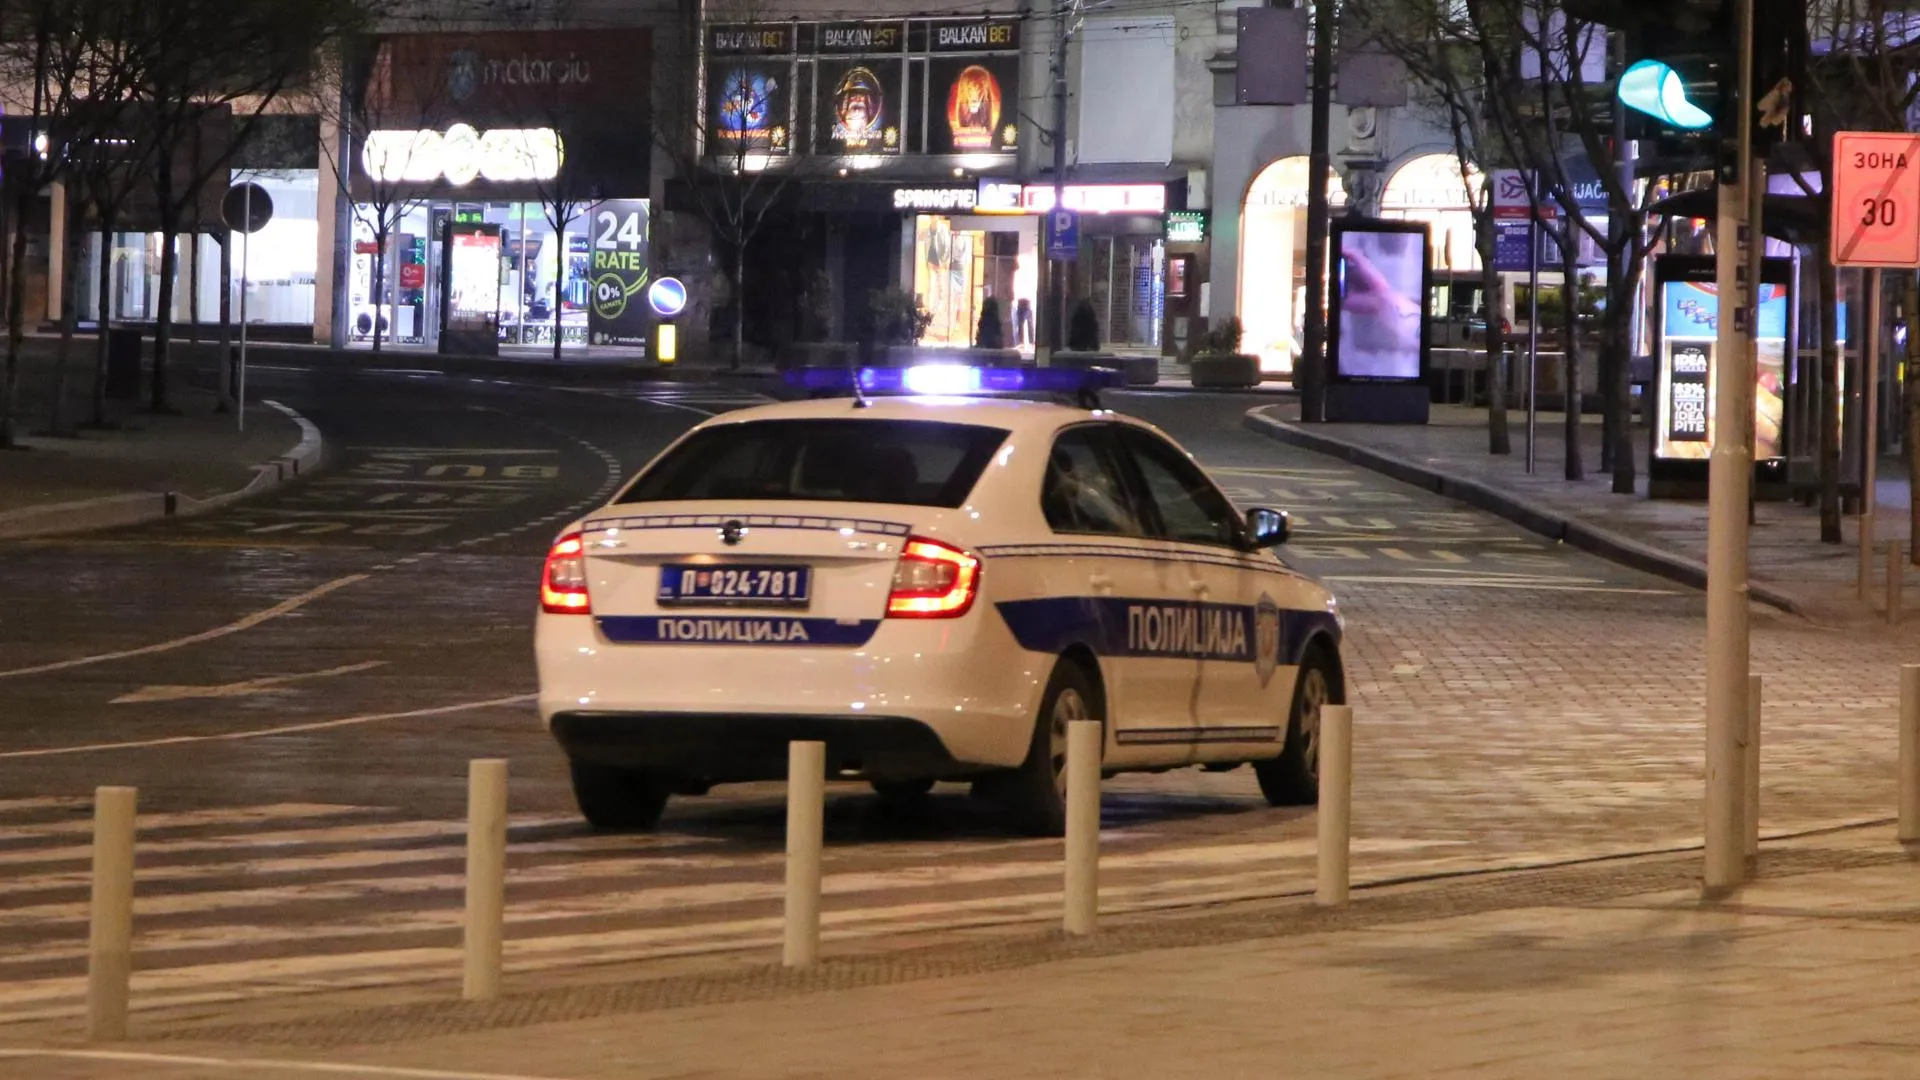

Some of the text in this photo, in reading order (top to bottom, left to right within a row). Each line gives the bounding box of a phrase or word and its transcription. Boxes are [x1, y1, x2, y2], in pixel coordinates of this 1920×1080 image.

[762, 31, 784, 48] BET
[825, 28, 897, 47] BALKAN BET
[939, 24, 1012, 45] BALKAN BET
[1862, 198, 1896, 227] 30
[596, 211, 642, 250] 24
[594, 251, 641, 271] RATE
[598, 282, 621, 302] 0%
[1674, 353, 1707, 367] IDEA
[1675, 401, 1705, 412] VOLI
[1675, 410, 1705, 421] IDEA
[1675, 420, 1705, 432] PITE
[681, 570, 697, 595] П
[657, 619, 809, 642] ПОЛИЦИЈА
[1127, 605, 1247, 659] ПОЛИЦИЈА
